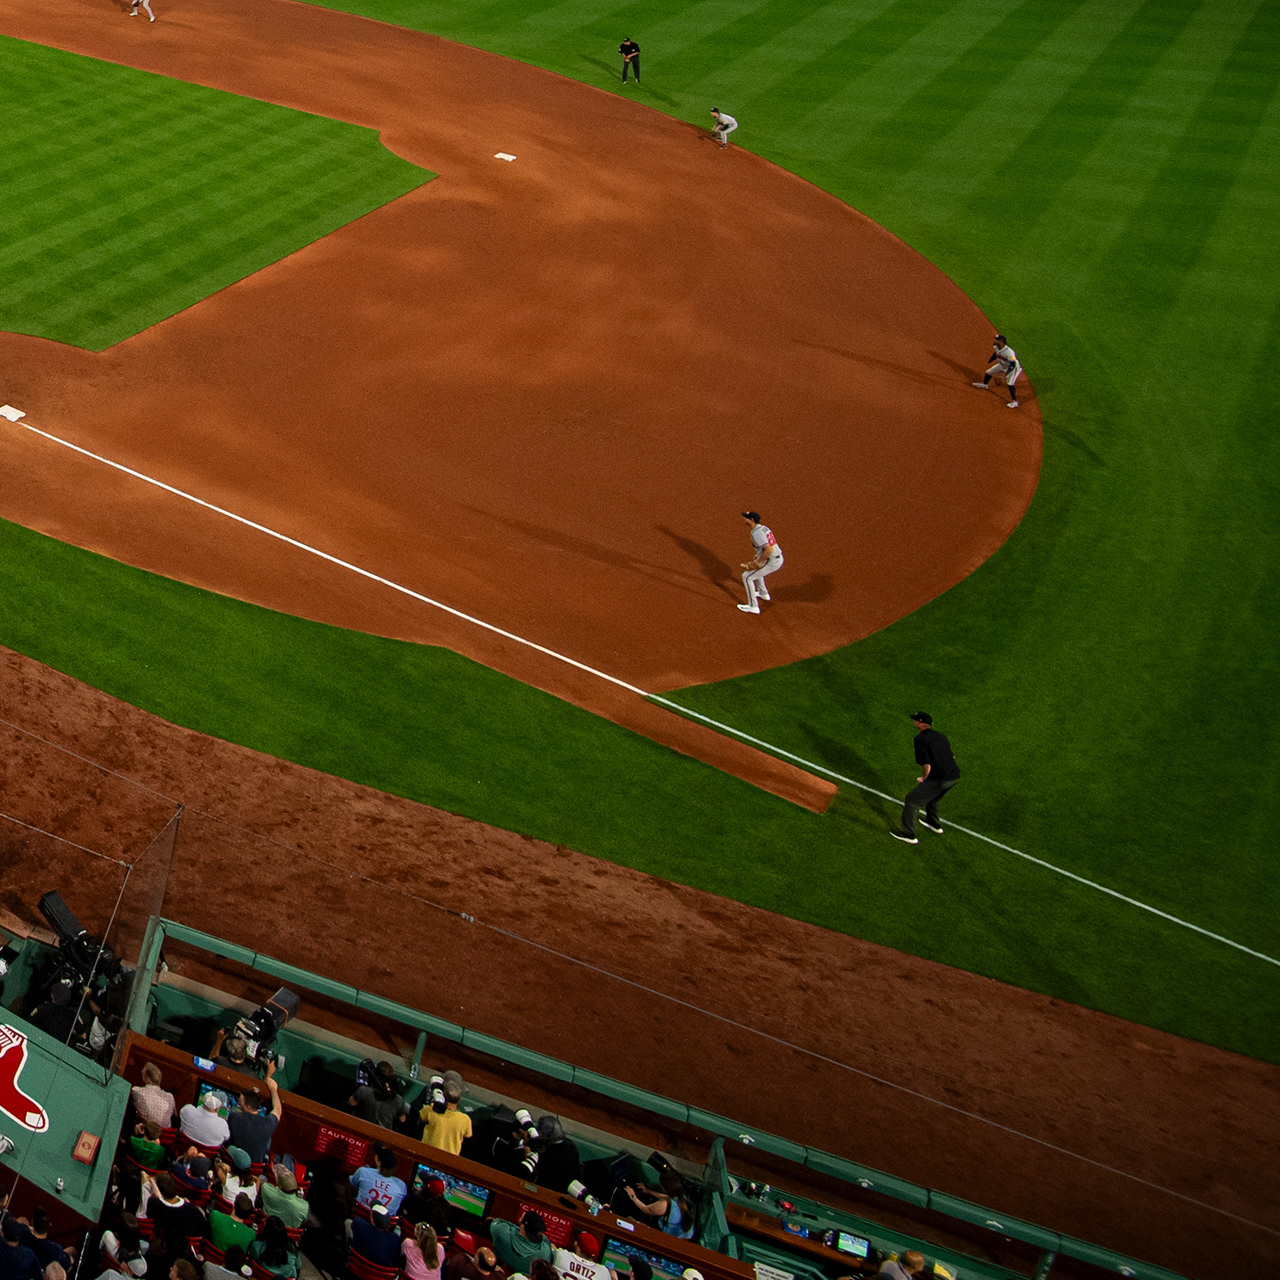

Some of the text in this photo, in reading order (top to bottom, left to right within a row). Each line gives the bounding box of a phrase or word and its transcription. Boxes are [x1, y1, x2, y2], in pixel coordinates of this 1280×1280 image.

[319, 1126, 366, 1149] CAUTION!
[373, 1178, 390, 1192] LEE
[569, 1261, 596, 1280] ORTIZ
